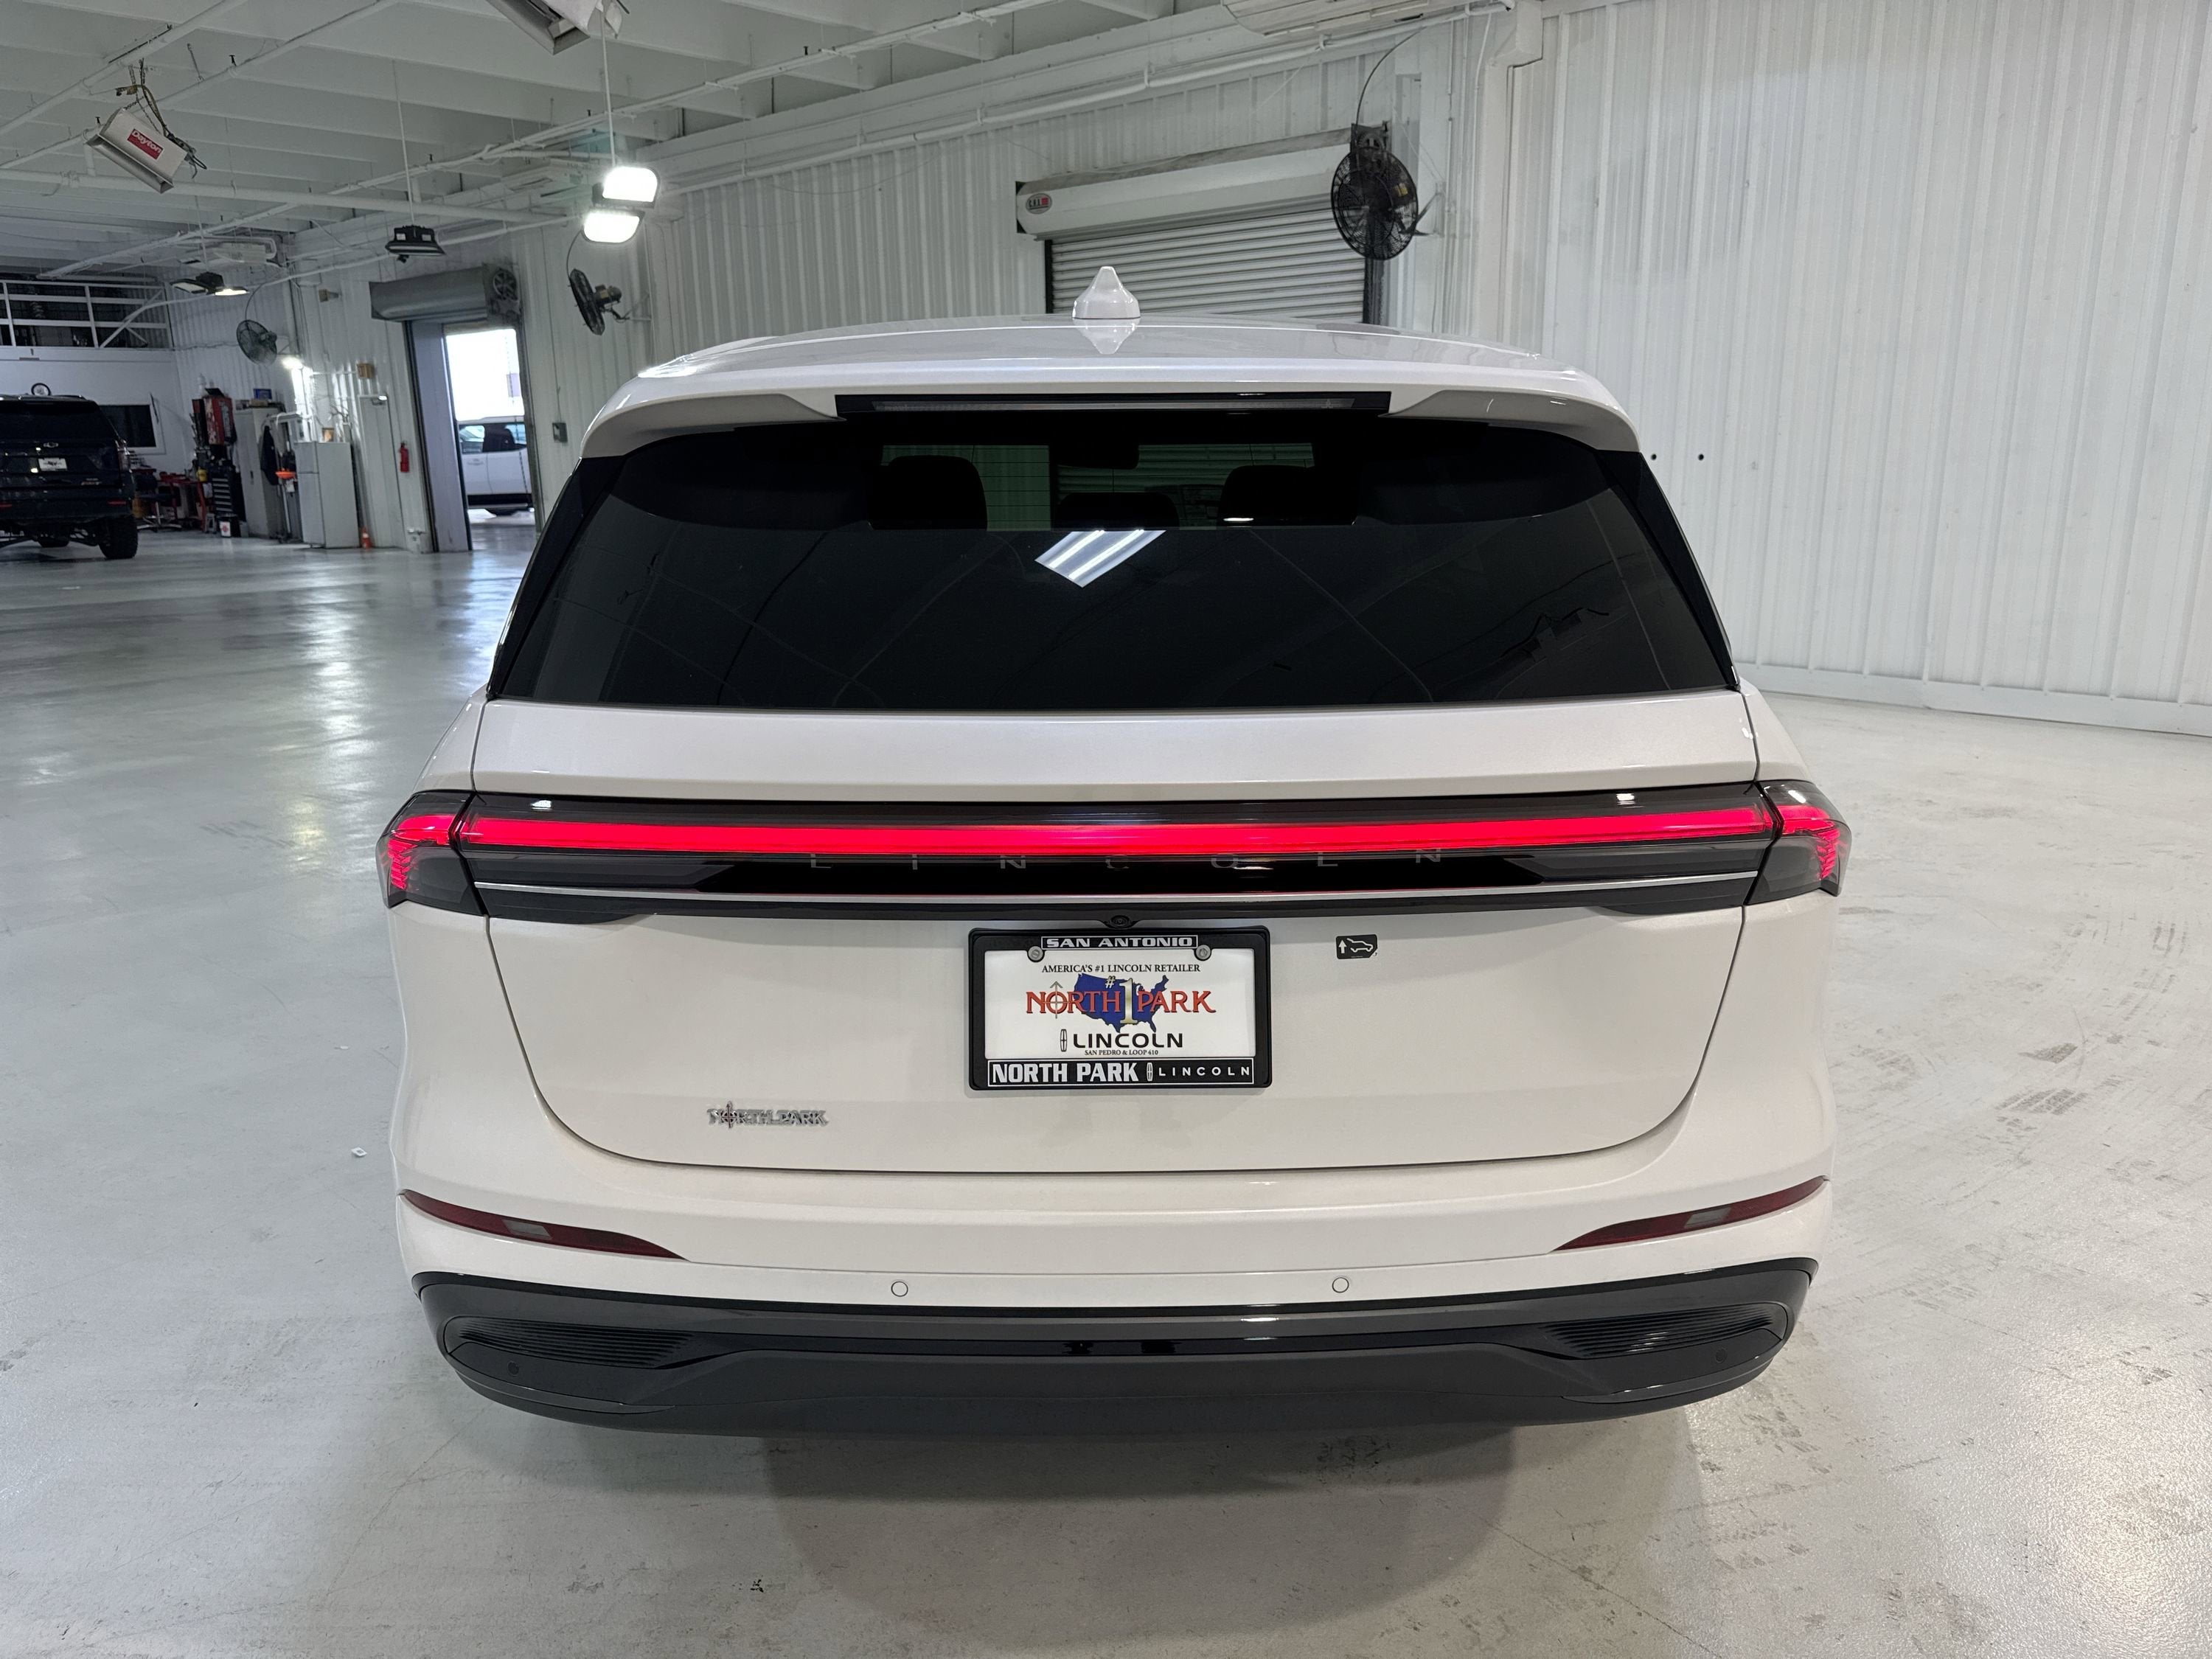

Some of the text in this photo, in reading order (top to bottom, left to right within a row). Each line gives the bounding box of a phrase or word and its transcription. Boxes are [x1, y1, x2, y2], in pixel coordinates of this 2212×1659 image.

[132, 131, 161, 153] Dayton
[810, 848, 1441, 871] LINCOLN
[1046, 937, 1193, 947] SAN ANTONIO
[1042, 964, 1093, 973] AMERICA'S
[1107, 964, 1152, 973] LINCOLN
[1155, 964, 1201, 972] RETAILER
[1026, 990, 1217, 1014] NORTH PARK
[1074, 1033, 1183, 1048] LINCOLN
[992, 1062, 1250, 1083] NORTH PARK LINCOLN
